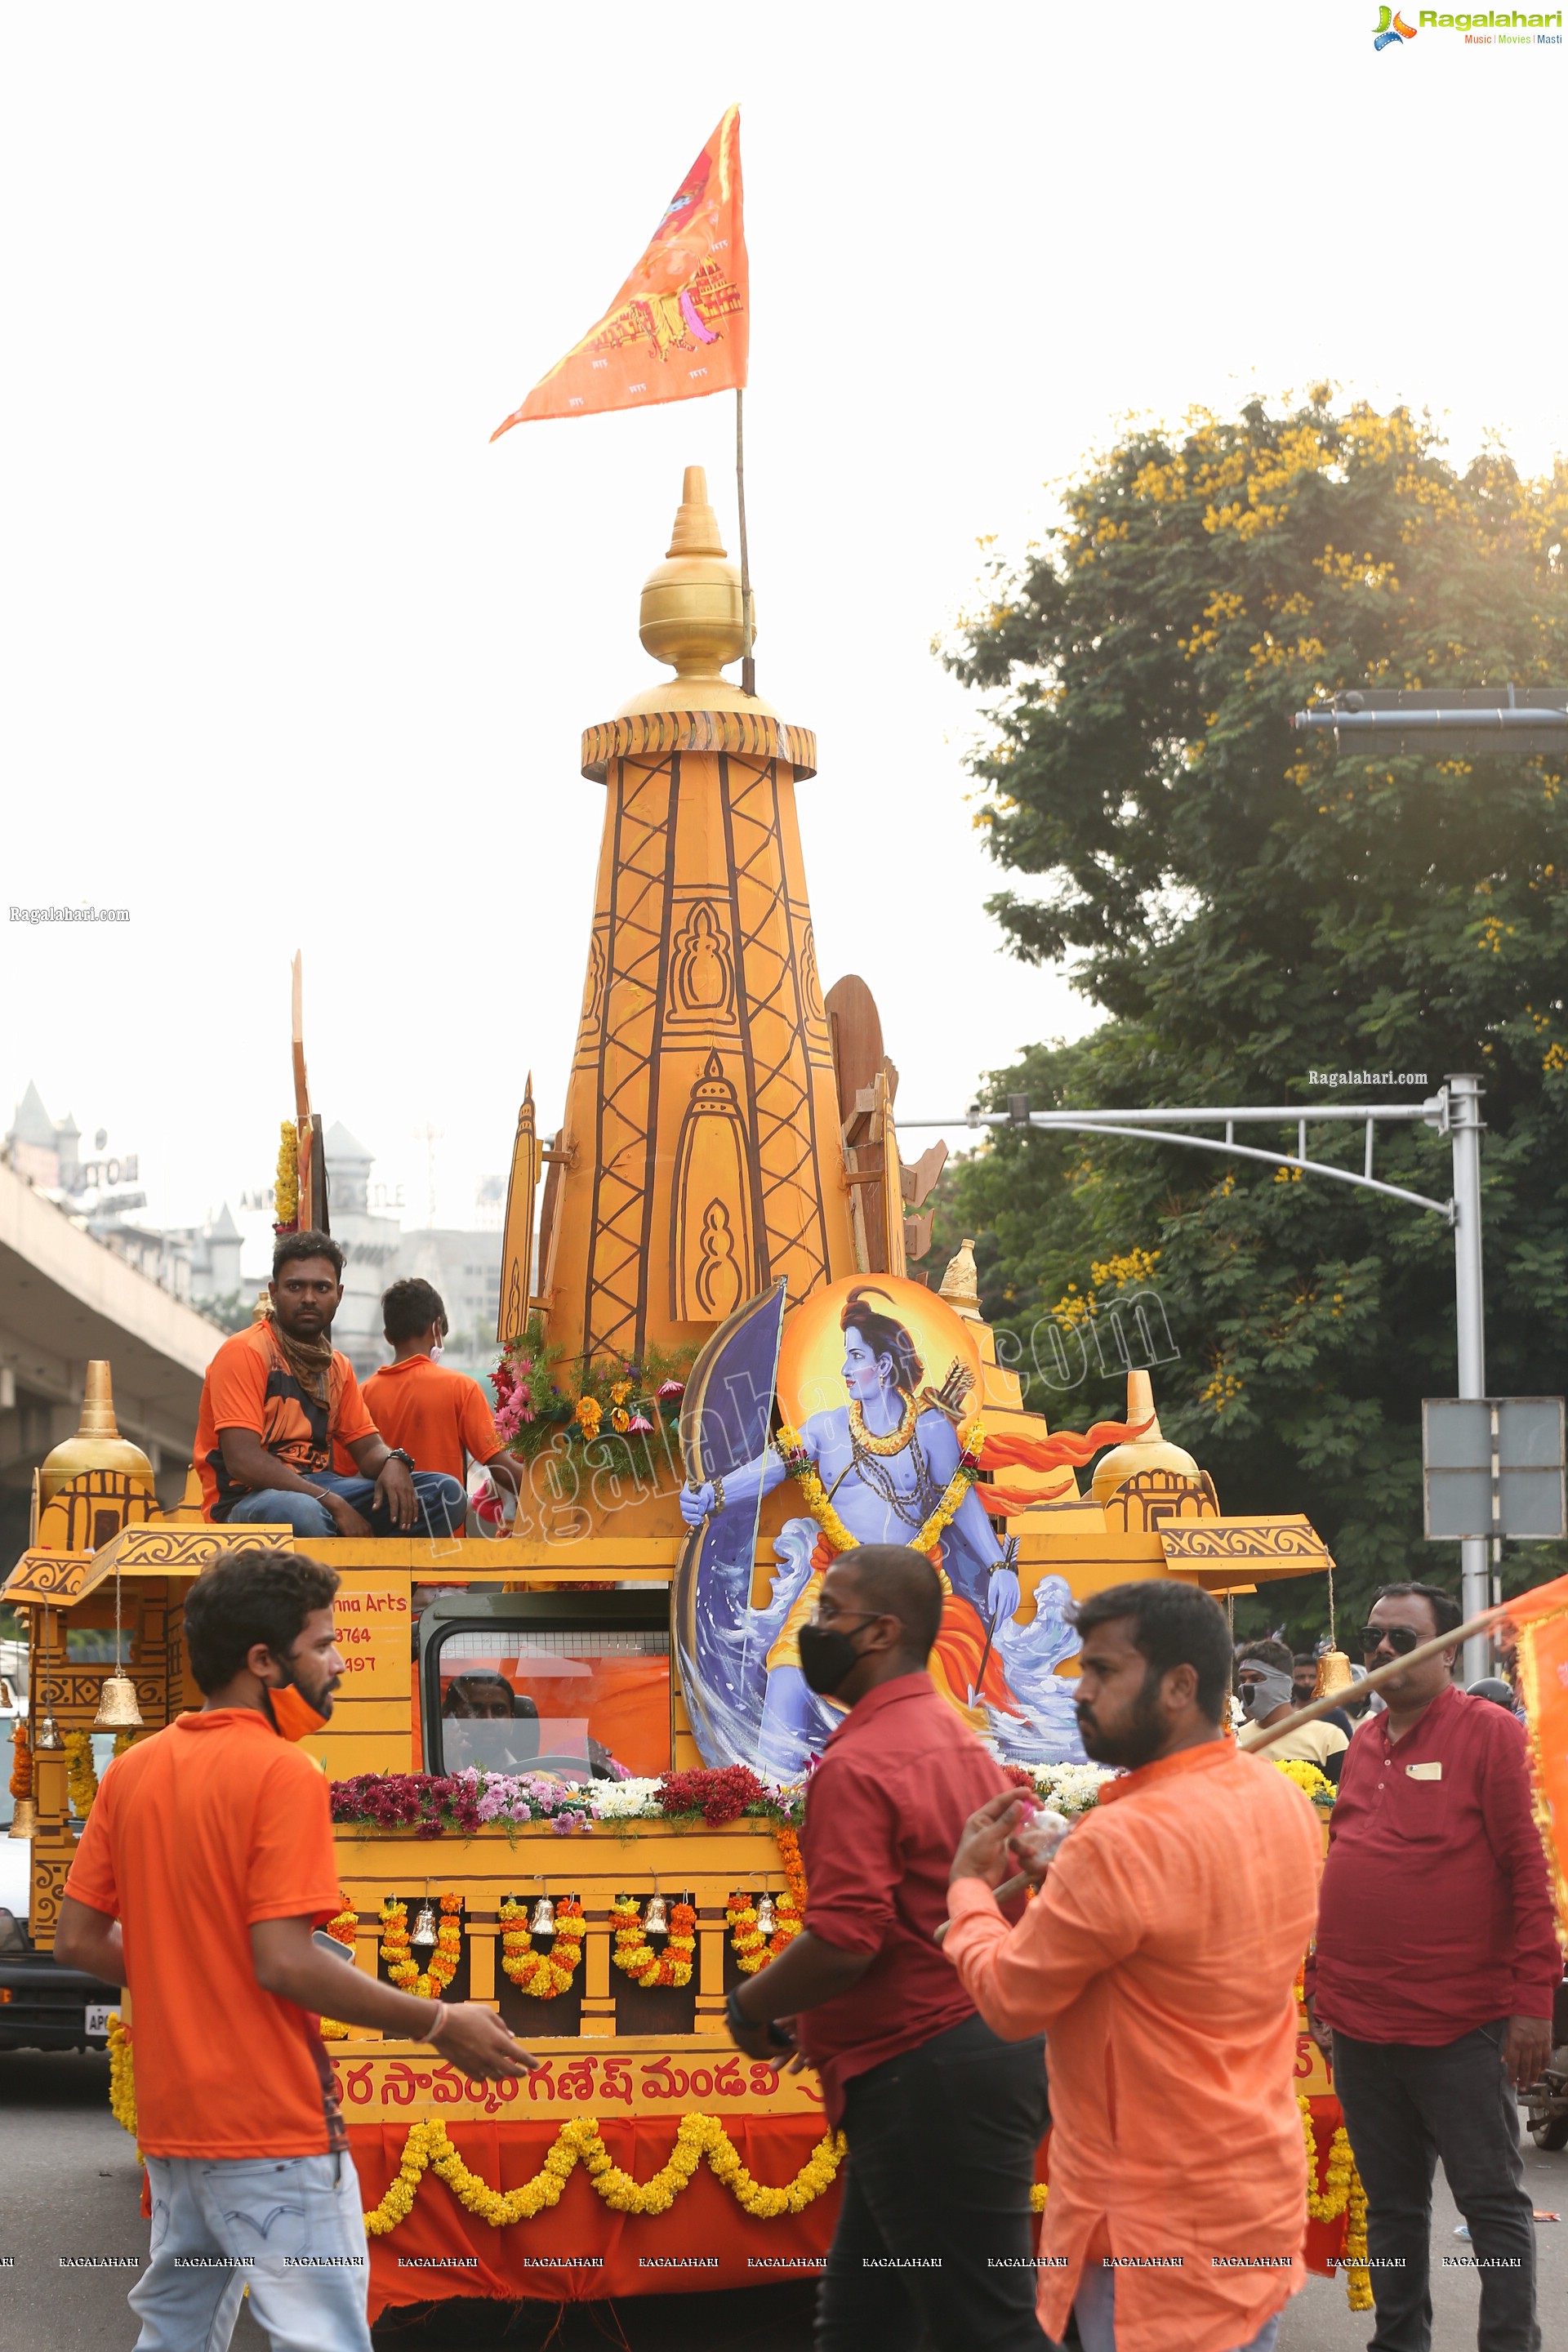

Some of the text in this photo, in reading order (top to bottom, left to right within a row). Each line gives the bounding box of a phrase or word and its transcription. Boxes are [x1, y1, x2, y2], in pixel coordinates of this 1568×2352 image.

[333, 1593, 407, 1612] nna Arts
[335, 1628, 372, 1644] 3764
[345, 1656, 376, 1673] 497
